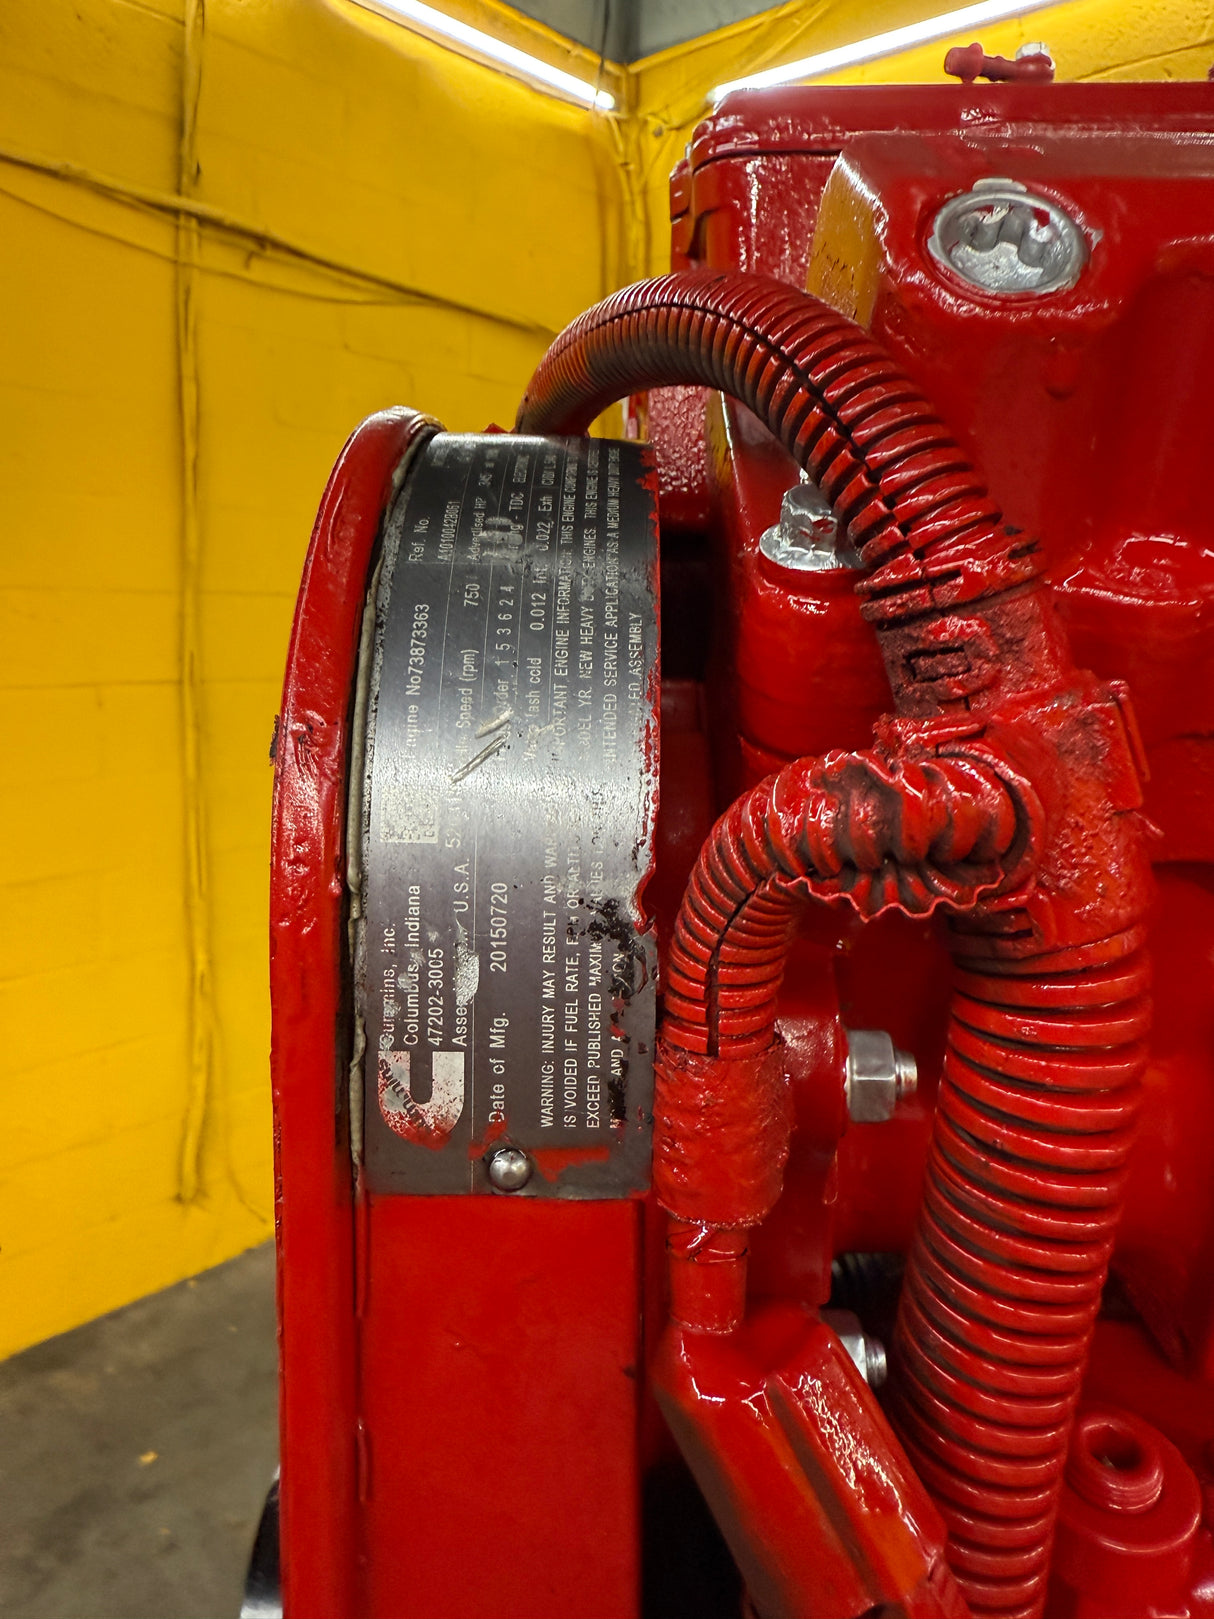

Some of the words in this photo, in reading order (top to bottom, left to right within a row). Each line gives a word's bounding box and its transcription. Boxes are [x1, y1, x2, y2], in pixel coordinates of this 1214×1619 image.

[508, 491, 524, 512] TDC
[414, 516, 430, 533] No.
[560, 525, 574, 545] THIS
[408, 539, 426, 562] Ref.
[464, 583, 480, 606] 750
[529, 592, 547, 631] 0.012
[580, 606, 594, 644] HEAVY
[628, 610, 642, 676] ASSEMBLY
[459, 649, 479, 681] (rpm)
[526, 657, 542, 684] cold
[554, 629, 569, 676] ENGINE
[580, 650, 593, 679] NEW
[604, 633, 618, 686] SERVICE
[455, 688, 474, 728] Speed
[453, 858, 470, 912] U.S.A.
[543, 875, 557, 904] AND
[566, 889, 579, 909] OR
[404, 885, 420, 947] Indiana
[490, 882, 508, 972] 20150720
[542, 910, 556, 962] RESULT
[542, 970, 556, 998] MAY
[565, 952, 581, 992] RATE,
[428, 948, 444, 1046] 47202-3005
[565, 998, 578, 1032] FUEL
[489, 1012, 509, 1048] Mfg.
[542, 1006, 555, 1053] INJURY
[564, 1038, 578, 1051] IF
[587, 993, 602, 1068] PUBLISHED
[489, 1058, 505, 1074] of
[611, 1049, 624, 1076] AND
[540, 1060, 554, 1128] WARNING:
[564, 1058, 578, 1109] VOIDED
[587, 1075, 600, 1128] EXCEED
[488, 1084, 505, 1123] Date
[564, 1116, 577, 1128] IS
